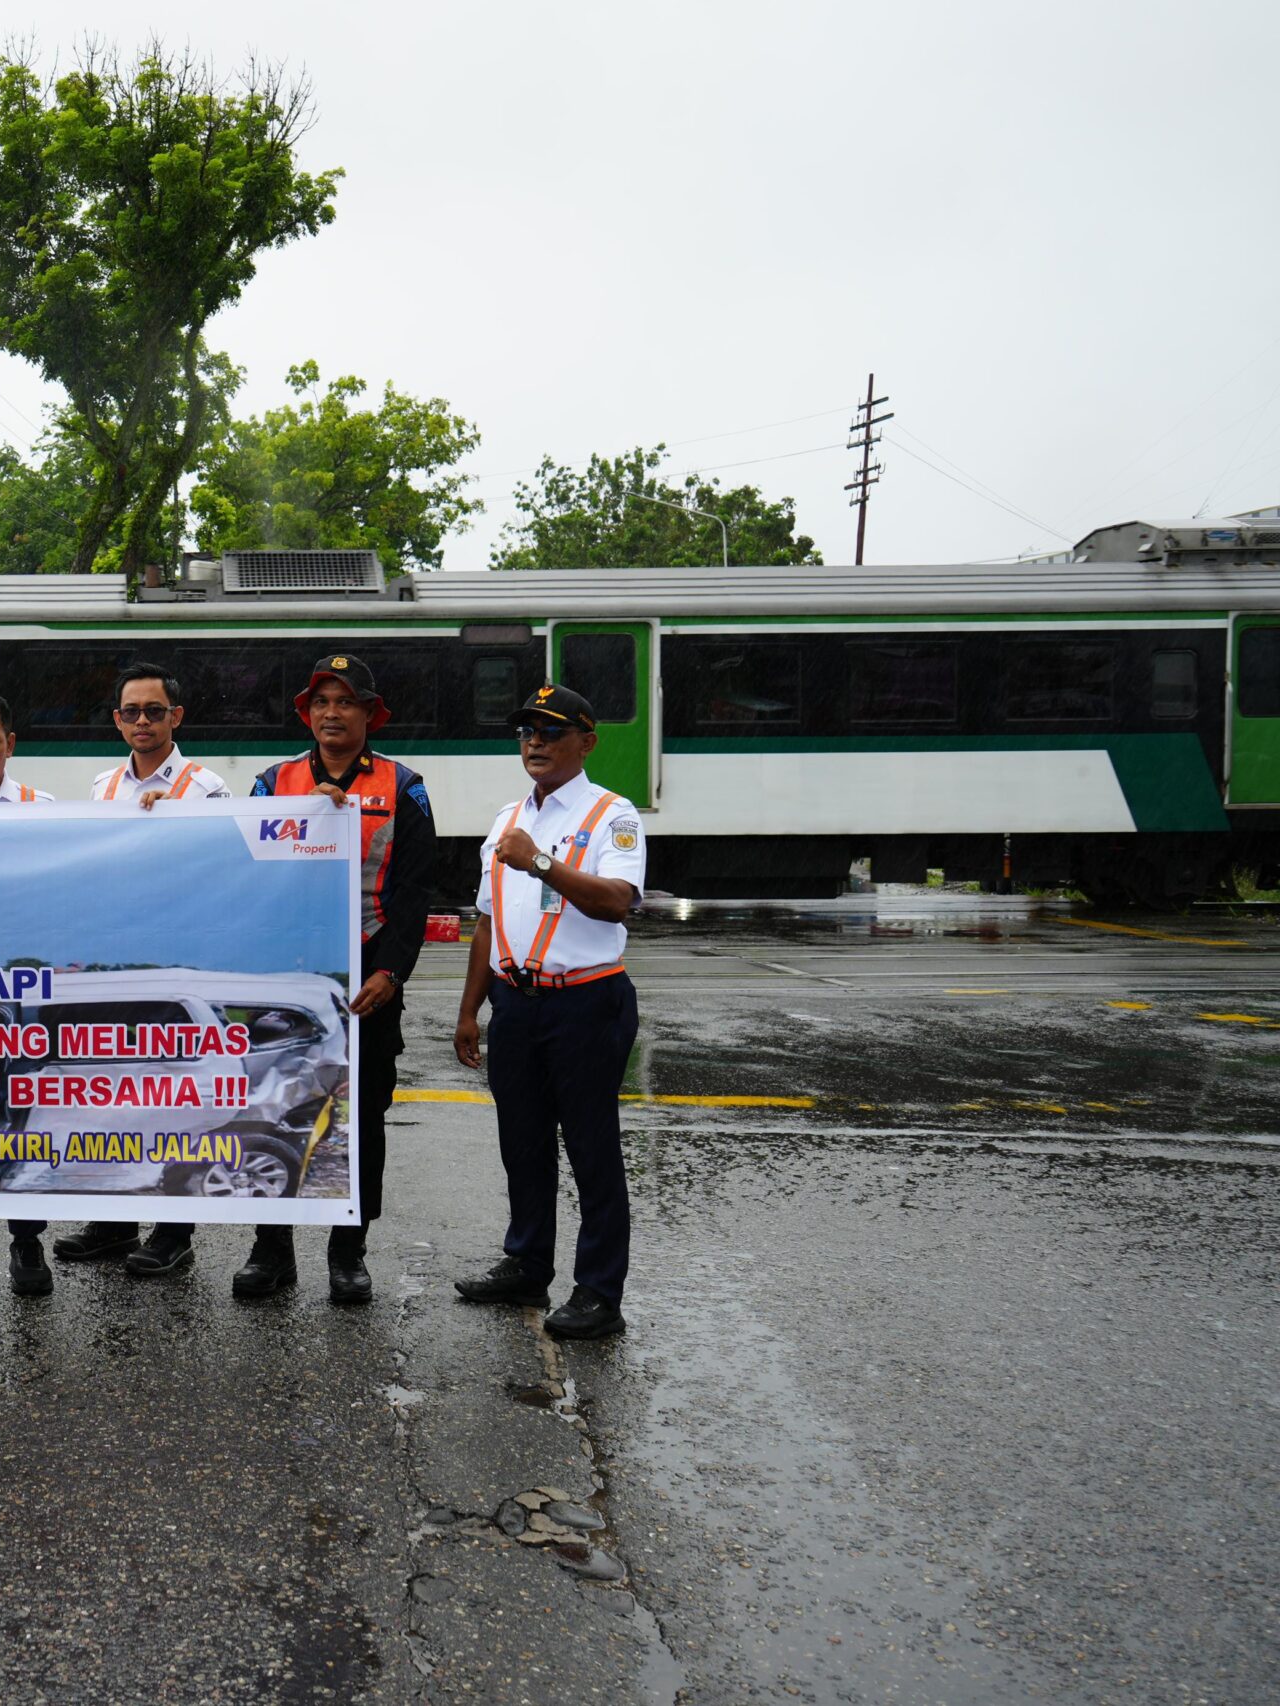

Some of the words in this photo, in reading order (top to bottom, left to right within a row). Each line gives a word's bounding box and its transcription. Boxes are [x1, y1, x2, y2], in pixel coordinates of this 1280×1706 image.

[260, 819, 308, 841] KAI
[560, 835, 576, 845] KA
[293, 843, 336, 855] Properti
[61, 1025, 248, 1056] MELINTAS
[11, 1076, 201, 1107] BERSAMA
[215, 1077, 247, 1107] !!!
[66, 1133, 142, 1162] AMAN
[149, 1133, 243, 1169] JALAN)
